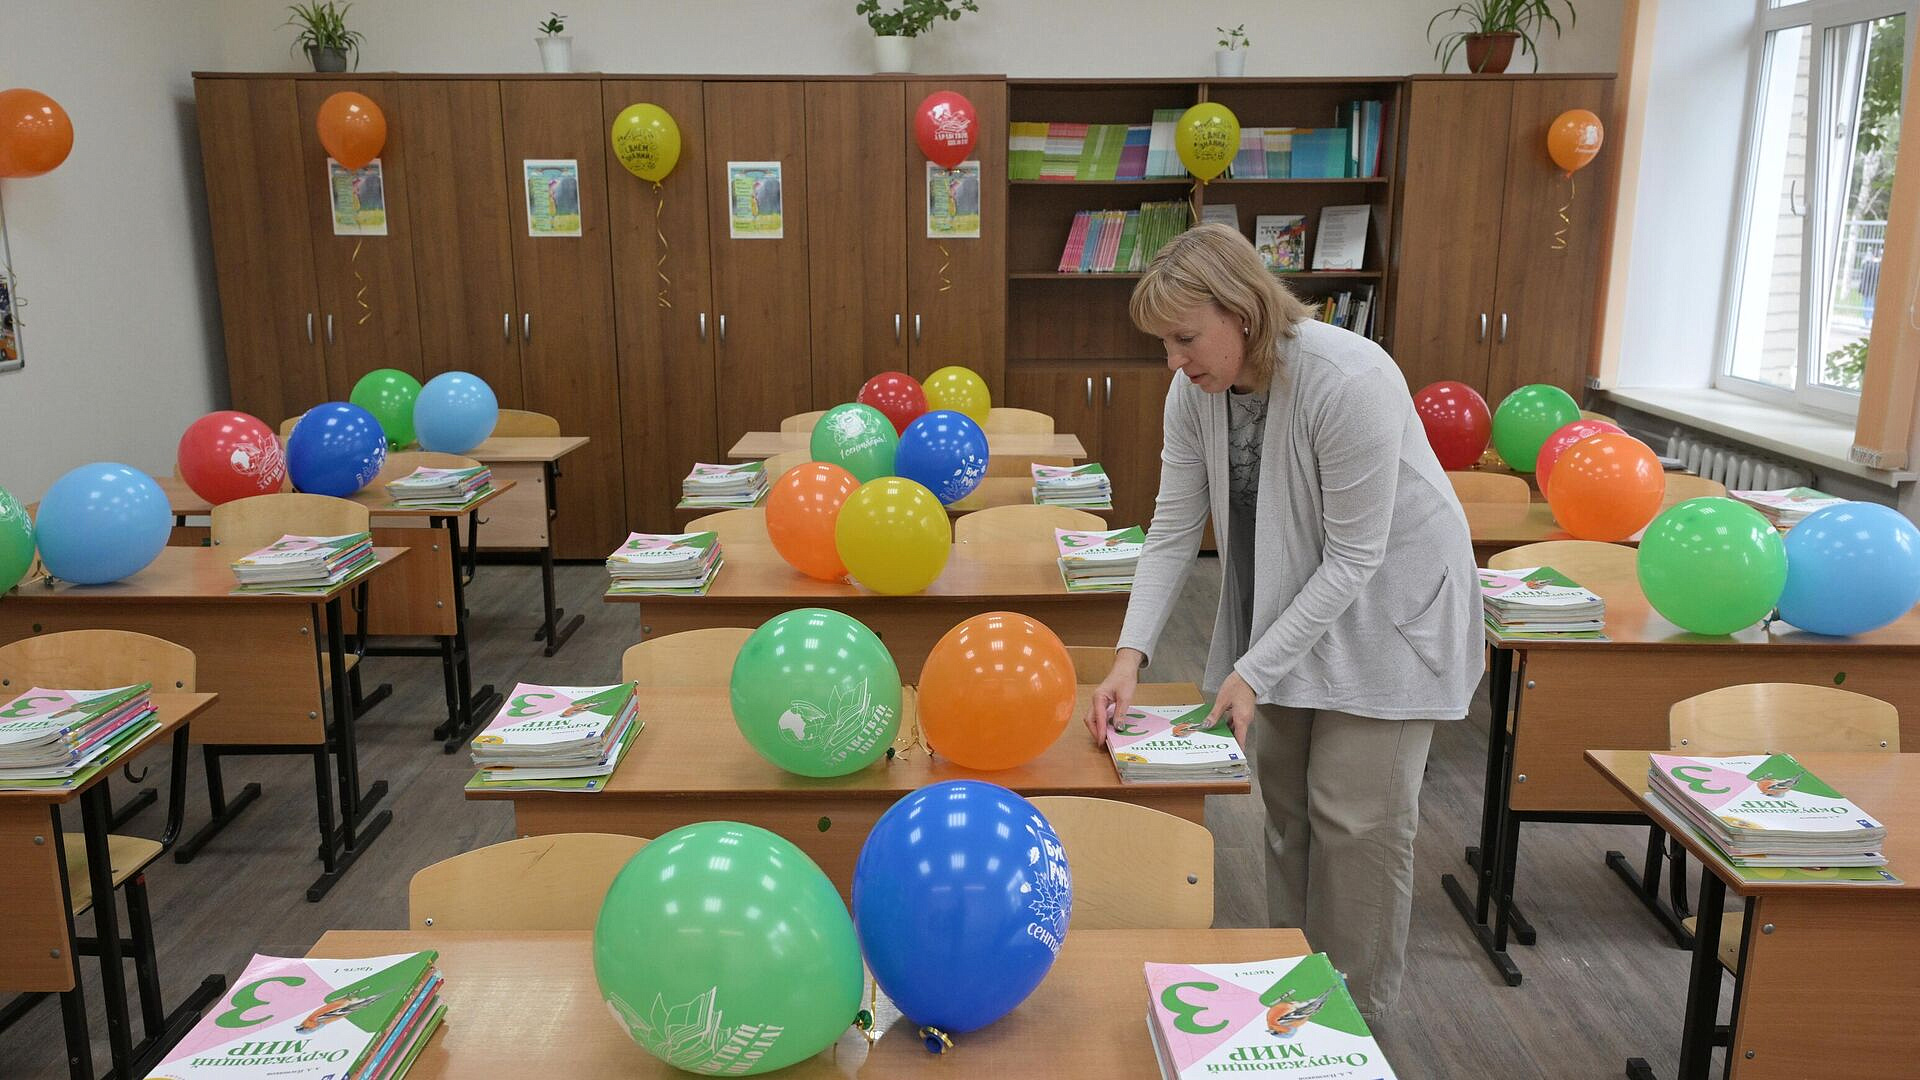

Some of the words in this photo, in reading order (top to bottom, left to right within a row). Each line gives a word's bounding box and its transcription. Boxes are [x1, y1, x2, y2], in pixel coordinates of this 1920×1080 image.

[0, 696, 64, 718] 3
[507, 694, 555, 717] 3
[1671, 765, 1731, 794] 3
[1741, 800, 1800, 809] МИР
[215, 976, 306, 1029] 3
[1160, 981, 1230, 1035] 3
[227, 1038, 313, 1056] МИР
[1228, 1042, 1307, 1062] МИР
[190, 1048, 349, 1069] Окружающий
[1206, 1052, 1368, 1075] Окружающий
